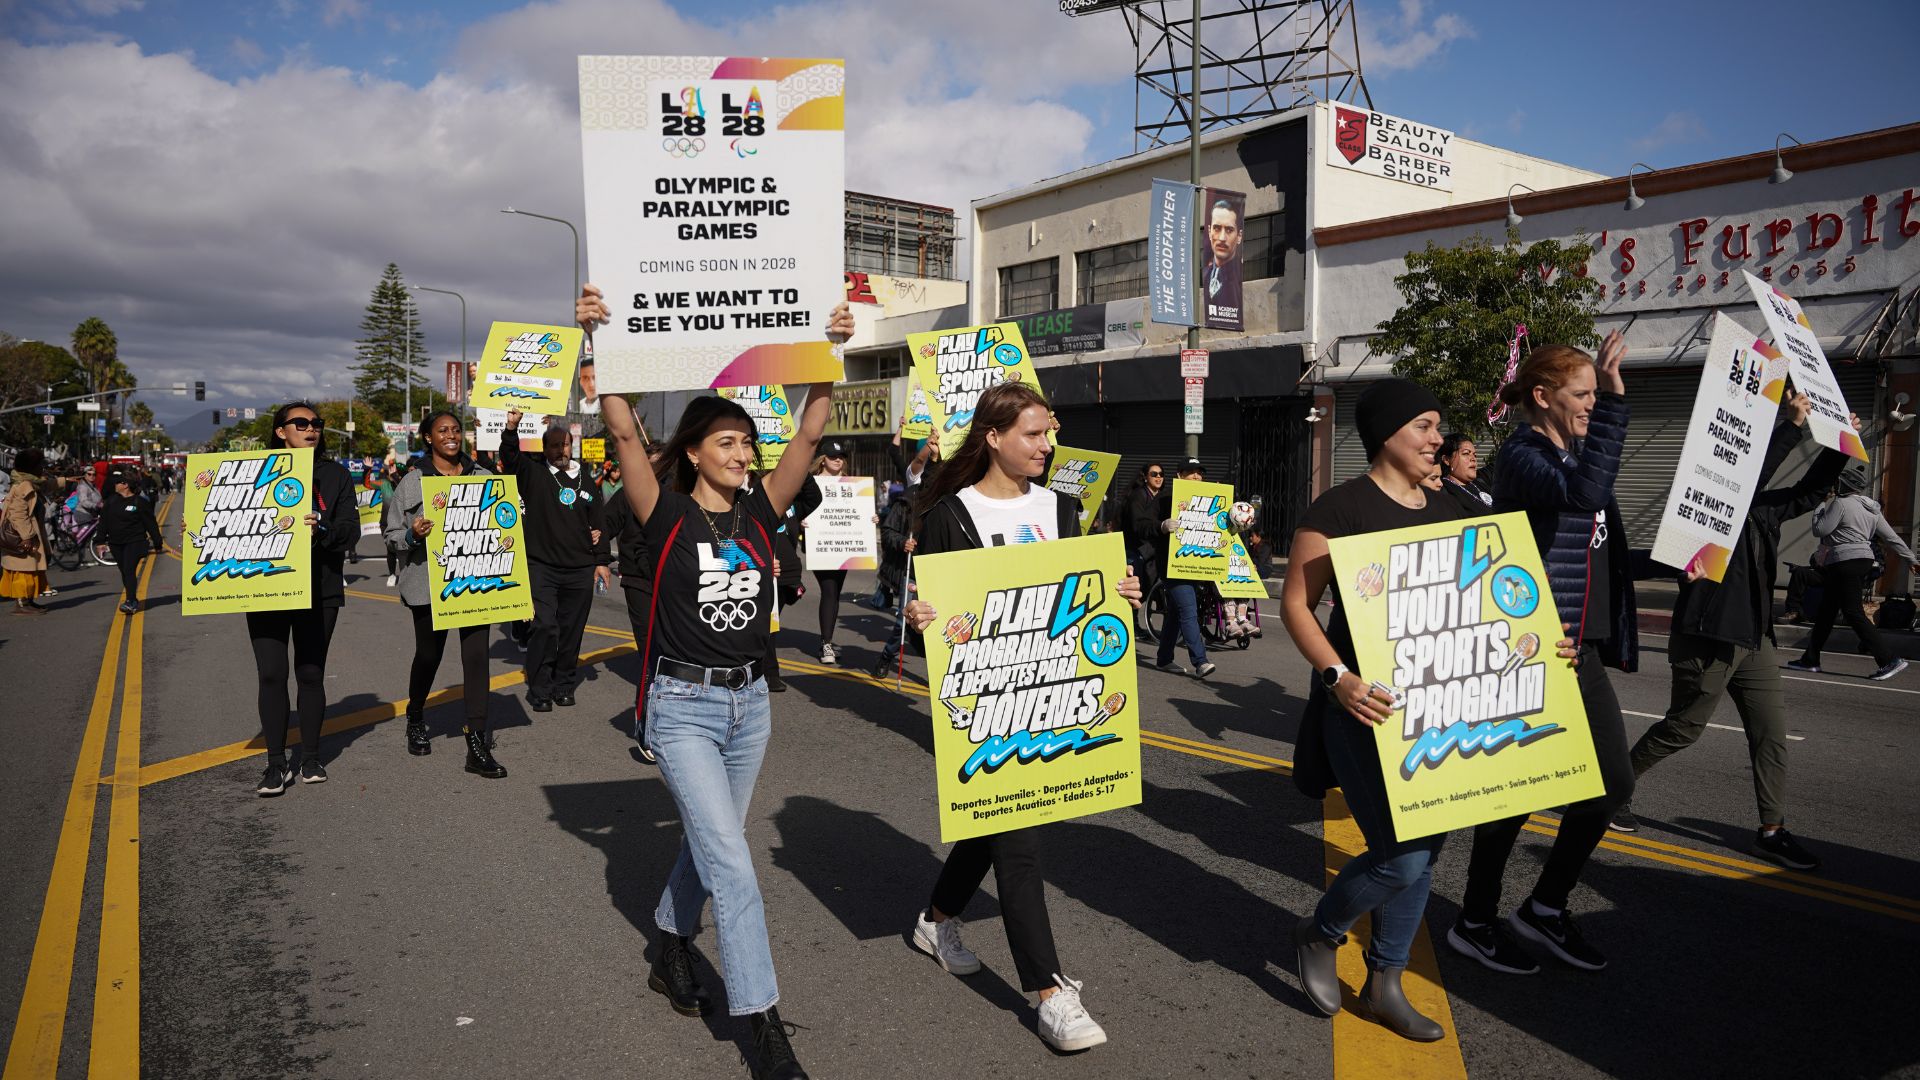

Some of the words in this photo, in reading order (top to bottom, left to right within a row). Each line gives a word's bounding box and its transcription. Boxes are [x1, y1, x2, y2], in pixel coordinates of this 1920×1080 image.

[722, 86, 764, 118] LA
[662, 115, 706, 136] 28
[722, 115, 765, 136] 28
[1370, 112, 1450, 144] BEAUTY
[1376, 129, 1443, 158] SALON
[1369, 145, 1450, 177] BARBER
[1383, 164, 1438, 186] SHOP
[655, 177, 755, 195] OLYMPIC
[761, 176, 777, 194] &
[643, 200, 790, 218] PARALYMPIC
[677, 223, 758, 240] GAMES
[1161, 190, 1177, 280] GODFATHER
[640, 259, 695, 273] COMING
[699, 259, 738, 272] SOON
[743, 258, 757, 271] IN
[761, 257, 796, 270] 2028
[633, 292, 650, 309] &
[655, 291, 690, 308] WE
[696, 289, 762, 307] WANT
[768, 288, 799, 305] TO
[1163, 284, 1176, 314] THE
[627, 316, 672, 333] SEE
[678, 314, 725, 331] YOU
[731, 311, 810, 329] THERE!
[1028, 311, 1073, 337] LEASE
[1107, 322, 1127, 332] CBRE
[938, 332, 978, 355] PLAY
[936, 349, 990, 374] YOUTH
[939, 366, 1005, 393] SPORTS
[1729, 365, 1743, 386] 28
[1746, 375, 1760, 395] 28
[834, 400, 887, 430] WIGS
[1716, 407, 1745, 434] OLYMPIC
[1746, 424, 1752, 437] &
[1708, 422, 1752, 454] PARALYMPIC
[1713, 444, 1738, 466] GAMES
[213, 459, 266, 485] PLAY
[254, 453, 293, 489] LA
[204, 483, 271, 511] YOUTH
[447, 483, 485, 507] PLAY
[479, 479, 505, 511] LA
[1684, 487, 1692, 500] &
[1692, 489, 1705, 506] WE
[1704, 495, 1724, 515] WANT
[1724, 505, 1735, 518] TO
[200, 507, 278, 537] SPORTS
[443, 506, 492, 532] YOUTH
[1677, 503, 1693, 522] SEE
[1693, 510, 1709, 528] YOU
[1709, 516, 1732, 536] THERE!
[197, 532, 294, 564] PROGRAM
[443, 528, 501, 555] SPORTS
[697, 539, 766, 572] LA
[443, 551, 515, 581] PROGRAM
[1388, 536, 1461, 592] PLAY
[1457, 522, 1507, 591] LA
[698, 569, 761, 603] 28
[980, 582, 1060, 637] PLAY
[1049, 570, 1105, 638] LA
[1387, 578, 1482, 641] YOUTH
[949, 625, 1080, 675] PROGRAMAS
[1393, 619, 1510, 689] SPORTS
[939, 672, 964, 700] DE
[961, 662, 1038, 697] DEPORTES
[1035, 655, 1080, 685] PARA
[968, 674, 1104, 744] JÓVENES
[1402, 662, 1546, 741] PROGRAM
[951, 798, 992, 813] Deportes
[994, 788, 1036, 804] Juveniles
[1043, 780, 1082, 796] Deportes
[1084, 770, 1129, 788] Adaptados
[973, 804, 1014, 820] Deportes
[1016, 796, 1057, 813] Acuáticos
[1063, 789, 1095, 803] Edades
[1096, 784, 1116, 797] 5-17
[1399, 801, 1420, 813] Youth
[1421, 797, 1444, 810] Sports
[1449, 789, 1481, 802] Adaptive
[1482, 784, 1504, 796] Sports
[1508, 779, 1527, 789] Swim
[1528, 774, 1550, 785] Sports
[1555, 769, 1571, 779] Ages
[1571, 764, 1587, 775] 5-17
